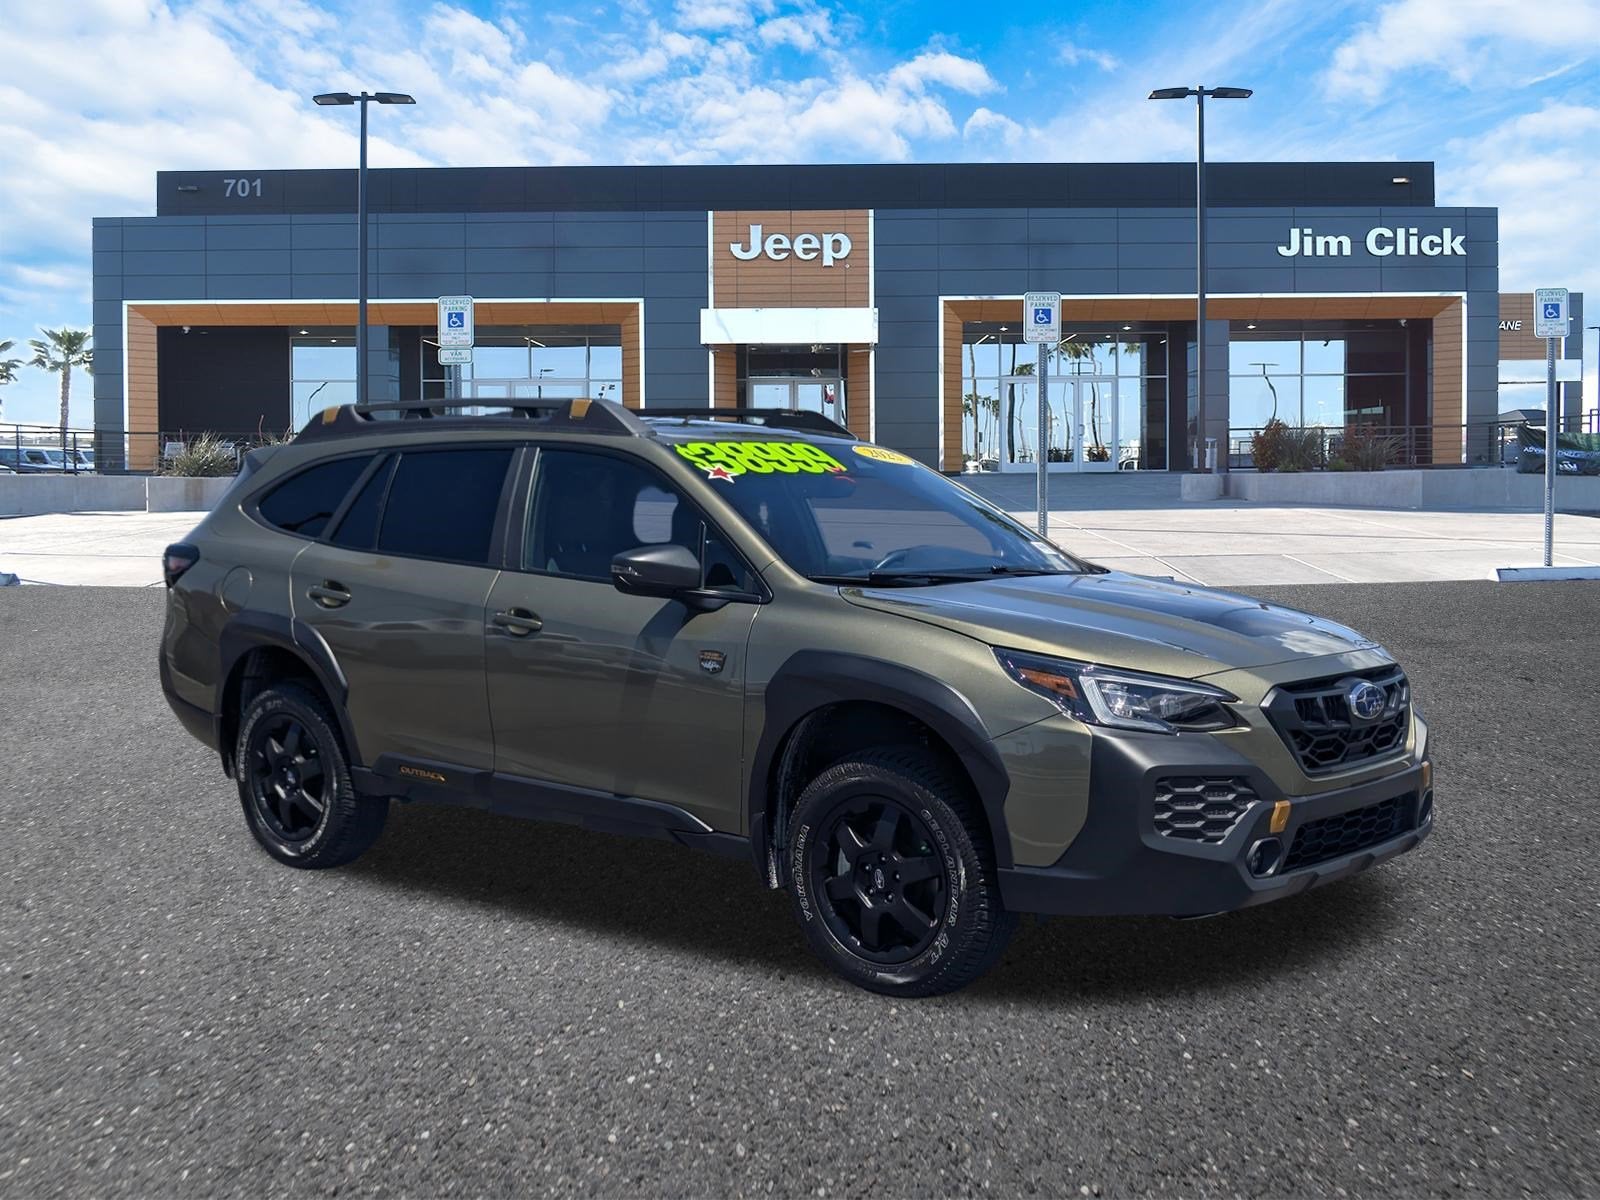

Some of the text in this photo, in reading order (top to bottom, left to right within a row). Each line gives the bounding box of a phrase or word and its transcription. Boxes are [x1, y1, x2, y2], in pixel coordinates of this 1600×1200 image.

[223, 179, 262, 197] 701
[729, 224, 852, 267] Jeep
[1277, 227, 1467, 257] Jim Click
[796, 824, 814, 922] YOKOHAMA
